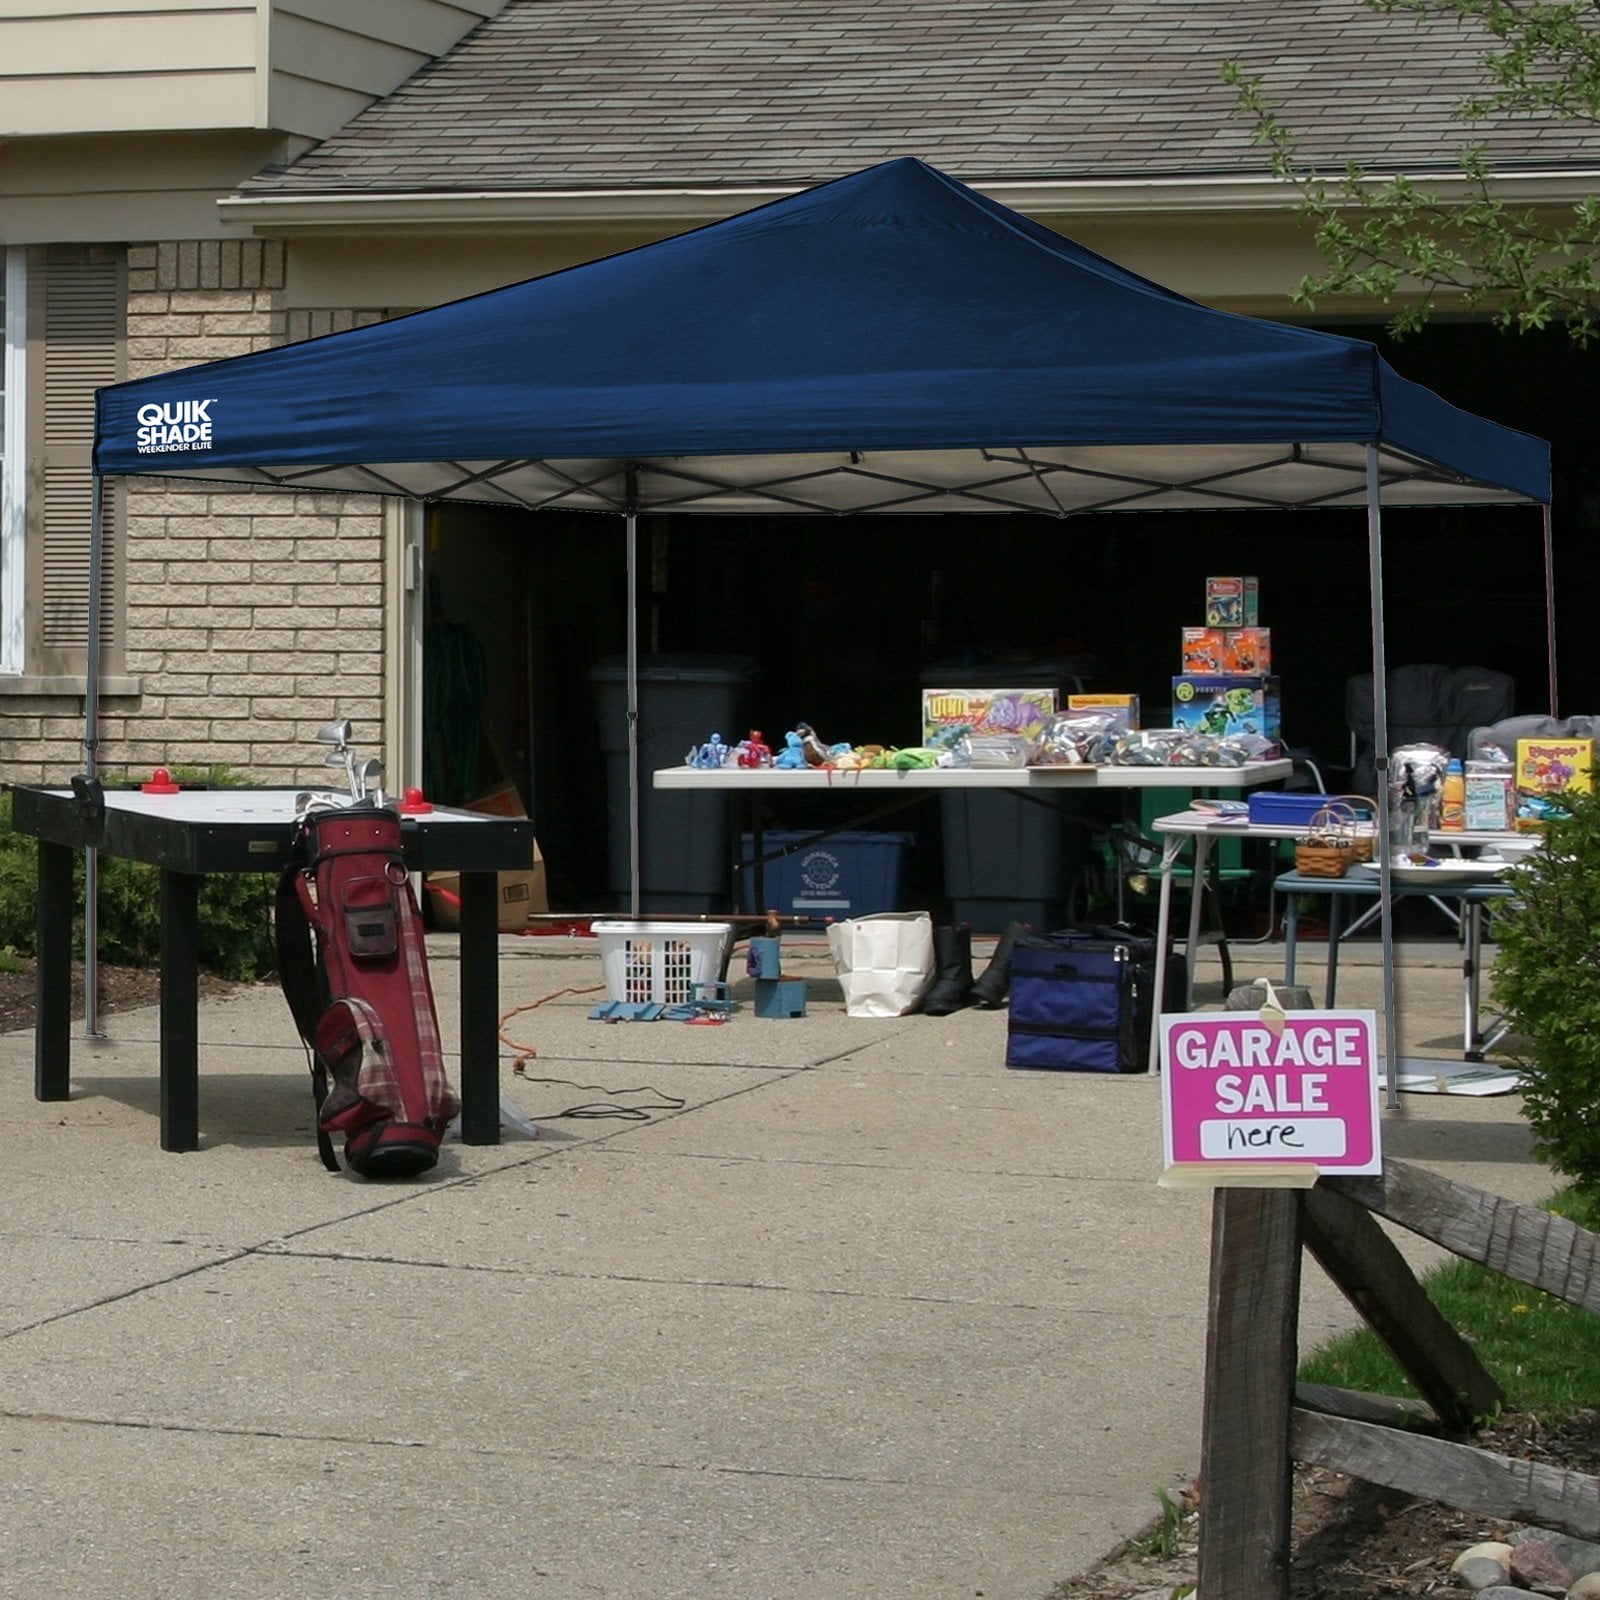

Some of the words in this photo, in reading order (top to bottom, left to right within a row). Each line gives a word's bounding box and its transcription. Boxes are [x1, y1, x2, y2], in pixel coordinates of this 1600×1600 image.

[137, 399, 212, 426] QUIK
[137, 423, 212, 446] SHADE
[138, 442, 190, 454] WEEKENDER
[192, 441, 212, 450] ELITE
[1176, 1028, 1362, 1069] GARAGE
[1215, 1073, 1329, 1114] SALE
[1227, 1122, 1304, 1150] here
